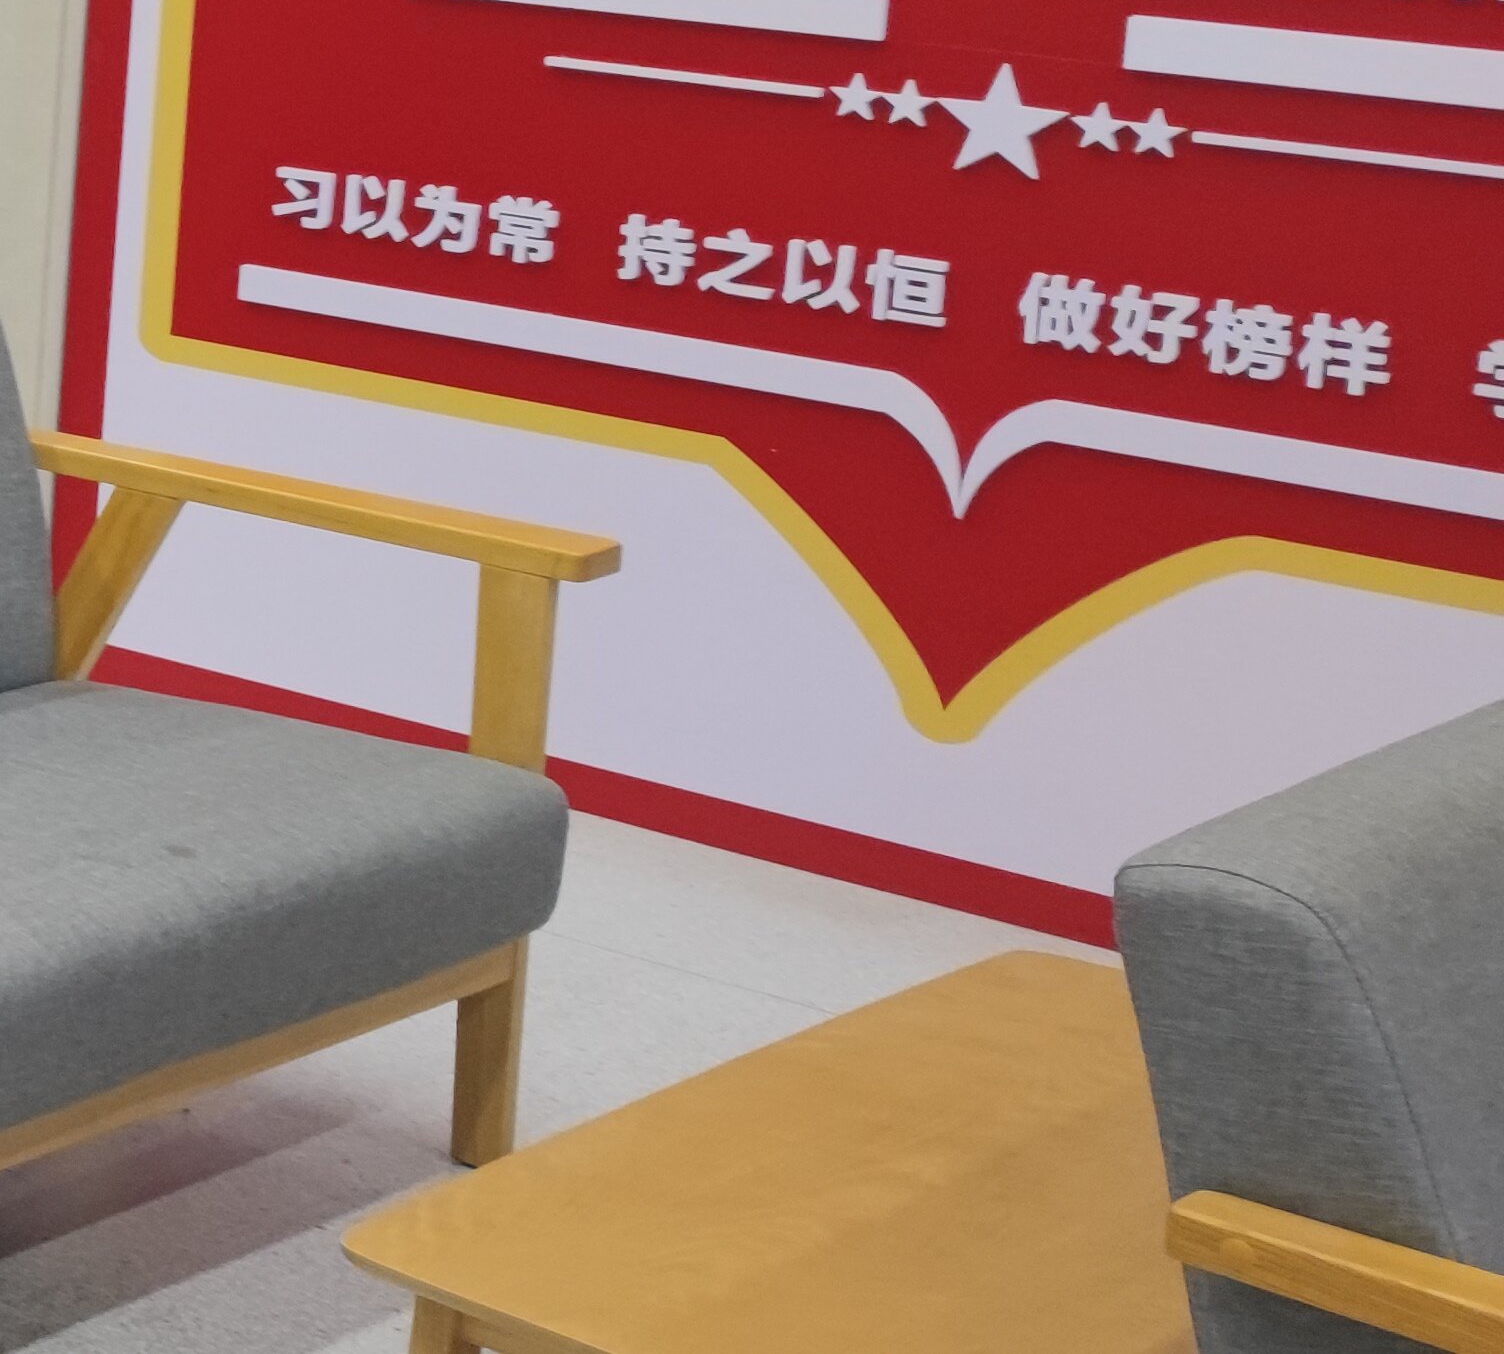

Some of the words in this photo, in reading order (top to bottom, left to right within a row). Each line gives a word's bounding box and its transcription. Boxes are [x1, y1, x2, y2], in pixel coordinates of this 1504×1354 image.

[271, 165, 561, 265] 习以为常
[616, 212, 951, 328] 持之以恒
[1017, 271, 1392, 398] 做好榜样
